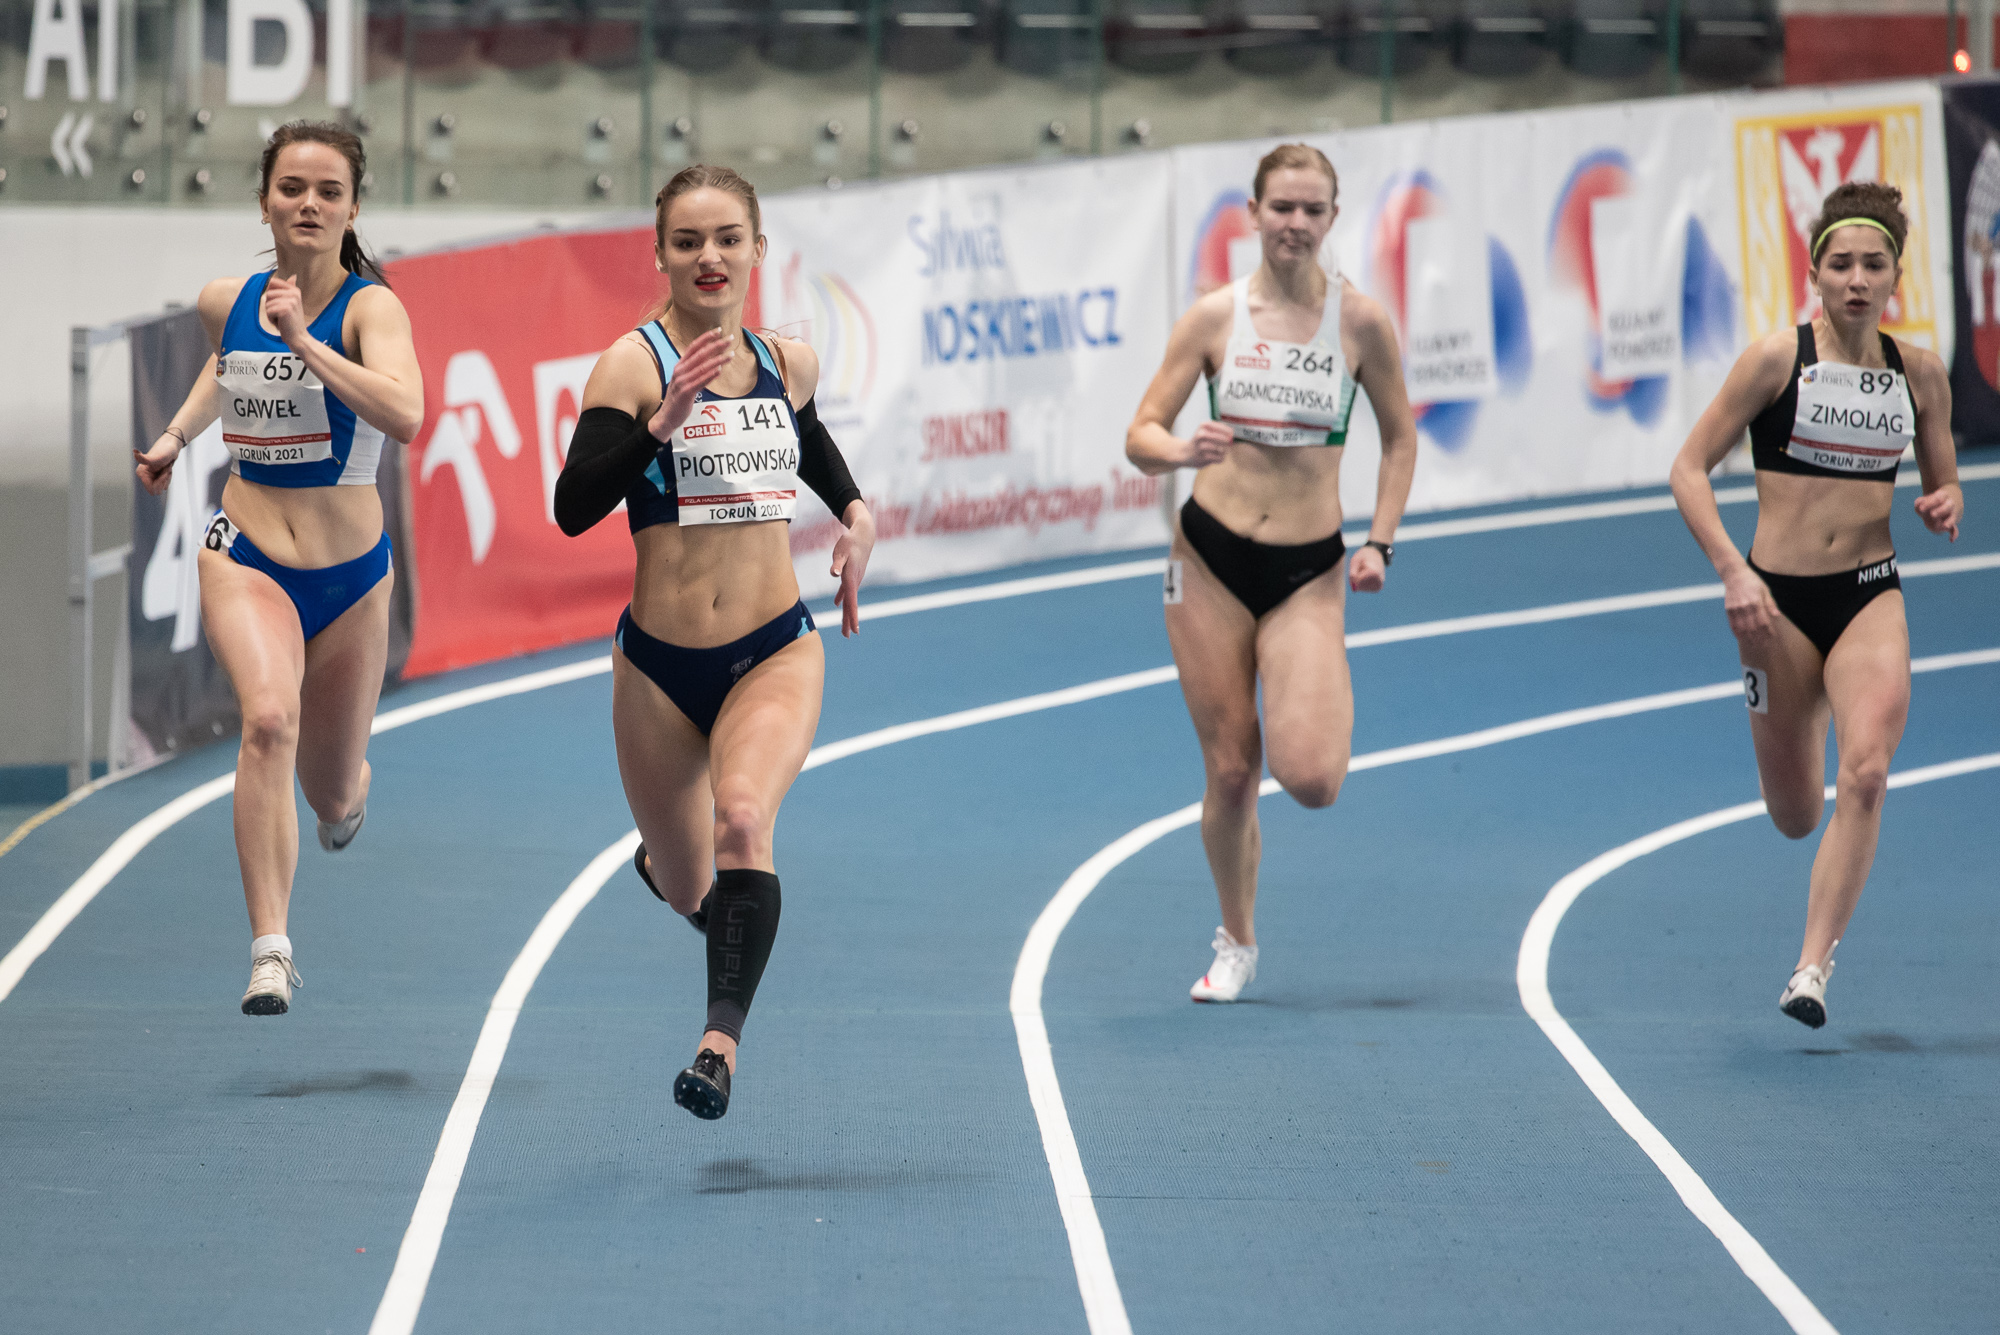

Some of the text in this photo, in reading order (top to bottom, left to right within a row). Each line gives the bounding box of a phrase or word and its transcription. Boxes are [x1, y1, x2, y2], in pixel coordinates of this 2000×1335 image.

[229, 356, 308, 381] TORUŃ 657
[1286, 348, 1333, 377] 264
[233, 398, 301, 419] GAWEŁ
[1224, 381, 1334, 411] ADAMCZEWSKA
[738, 404, 786, 431] 141
[1810, 403, 1904, 437] ZIMOLĄG
[685, 424, 725, 438] ORLEN
[239, 447, 304, 461] TORUŃ 2021
[680, 448, 797, 478] PIOTROWSKA
[1814, 452, 1882, 470] TORUŃ 2021
[709, 502, 783, 520] TORUŃ 2021
[205, 517, 230, 552] 6
[1858, 561, 1890, 585] NIKE
[1746, 671, 1759, 708] 3
